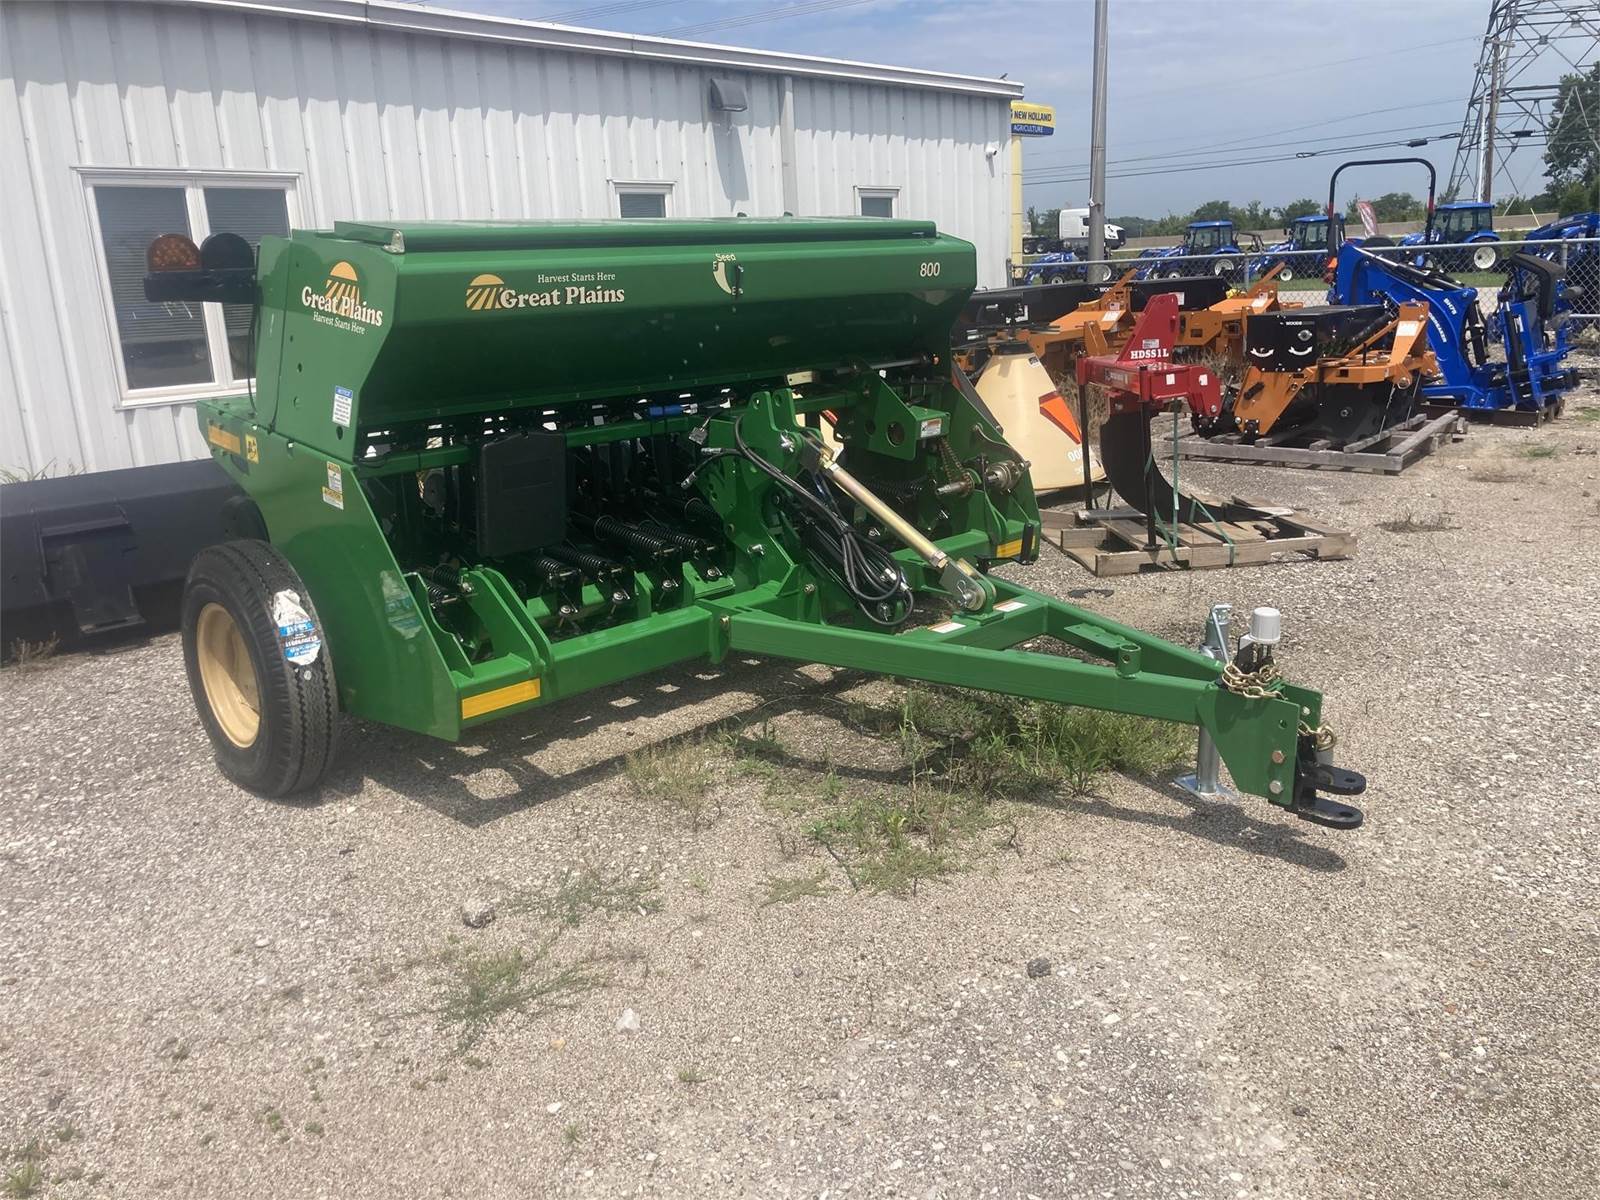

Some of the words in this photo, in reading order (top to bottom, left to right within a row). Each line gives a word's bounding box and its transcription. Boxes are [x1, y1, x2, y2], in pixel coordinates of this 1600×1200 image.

[1014, 111, 1027, 120] NEW
[1028, 112, 1052, 122] HOLLAND
[920, 262, 940, 277] 800
[537, 274, 569, 284] Harvest
[571, 272, 595, 282] Starts
[597, 271, 616, 281] Here
[500, 289, 561, 309] Great
[565, 286, 625, 304] Plains
[302, 286, 338, 314] Great
[341, 295, 383, 327] Plains
[313, 311, 334, 326] Harvest
[335, 317, 351, 331] Starts
[351, 322, 366, 335] Here
[1130, 348, 1169, 360] HDSS1L
